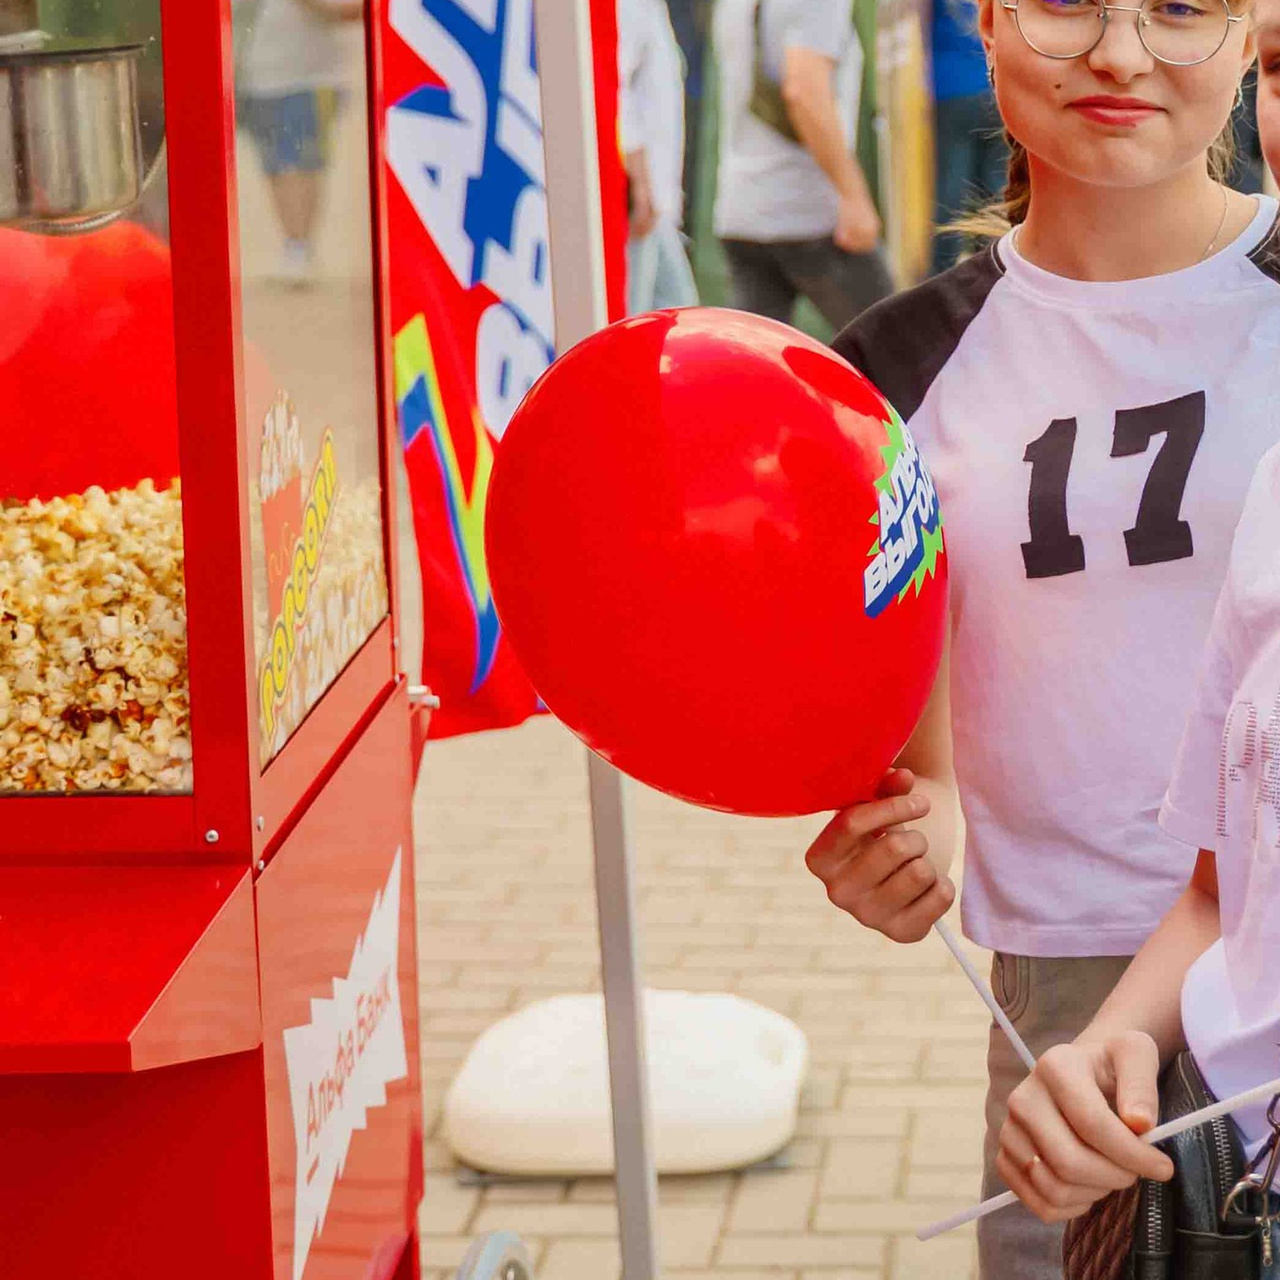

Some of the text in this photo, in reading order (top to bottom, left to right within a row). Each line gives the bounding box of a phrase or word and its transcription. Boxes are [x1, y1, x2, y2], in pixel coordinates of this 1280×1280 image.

[1020, 390, 1206, 579] 17
[305, 964, 392, 1155] Альфа Банк
